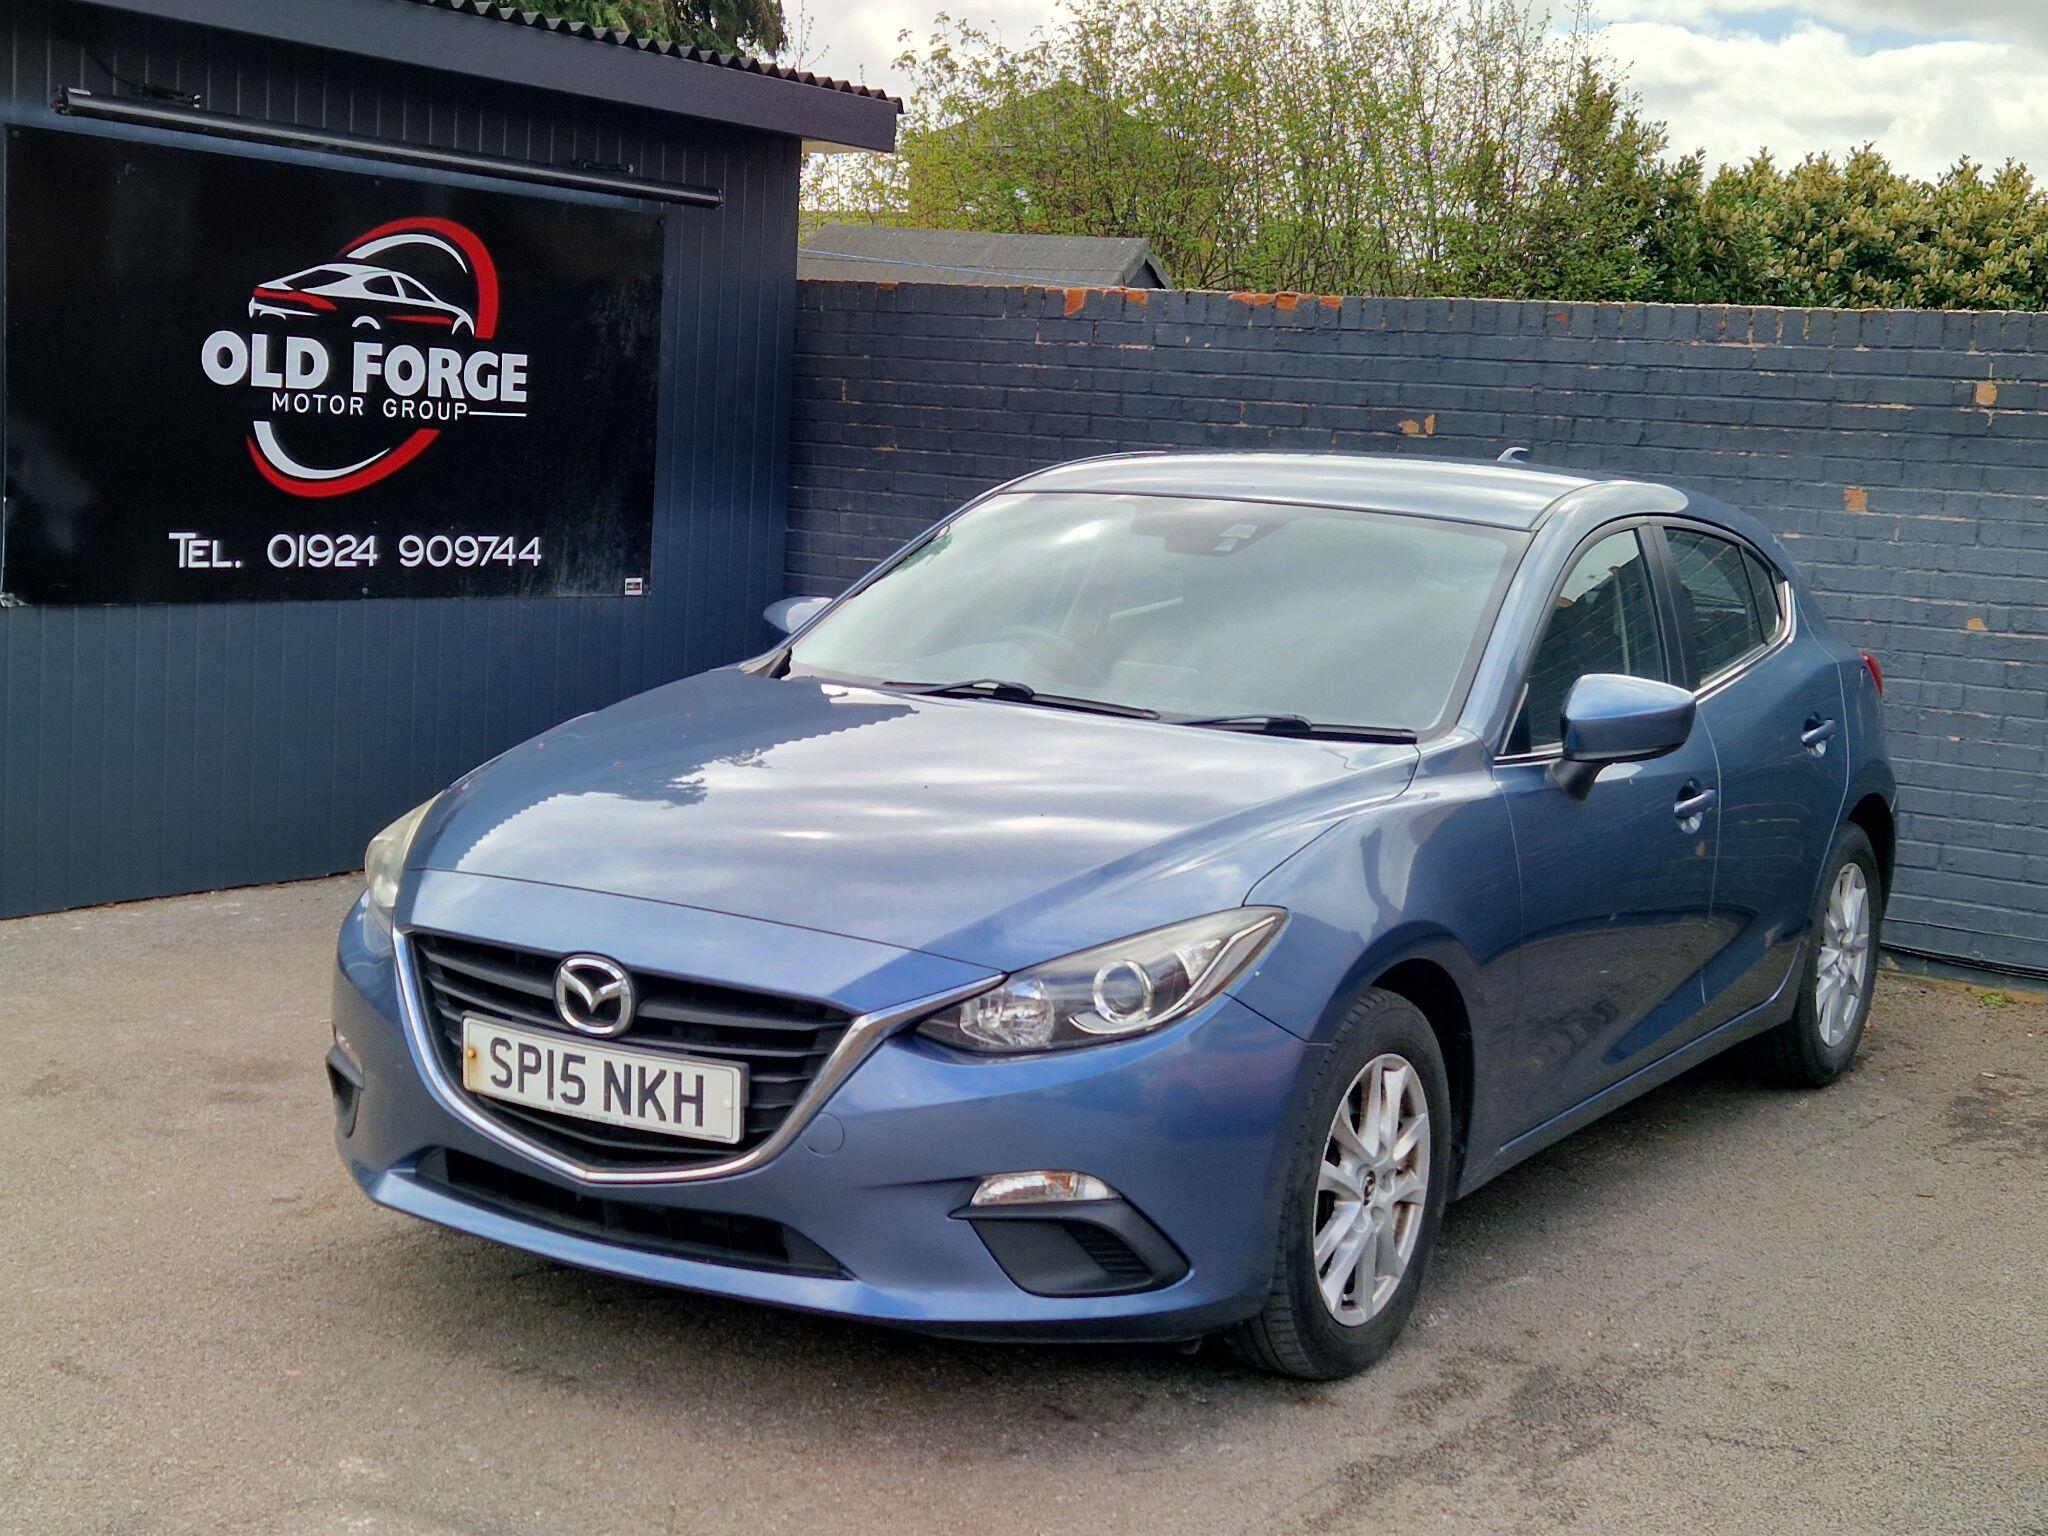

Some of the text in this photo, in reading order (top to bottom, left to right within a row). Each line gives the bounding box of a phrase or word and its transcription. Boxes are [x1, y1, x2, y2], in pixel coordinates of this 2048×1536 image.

[201, 330, 528, 403] OLD FORGE
[271, 391, 469, 421] MOTOR GROUP
[266, 533, 378, 568] 01924
[398, 534, 542, 568] 909744
[489, 1037, 705, 1128] SP15 NKH
